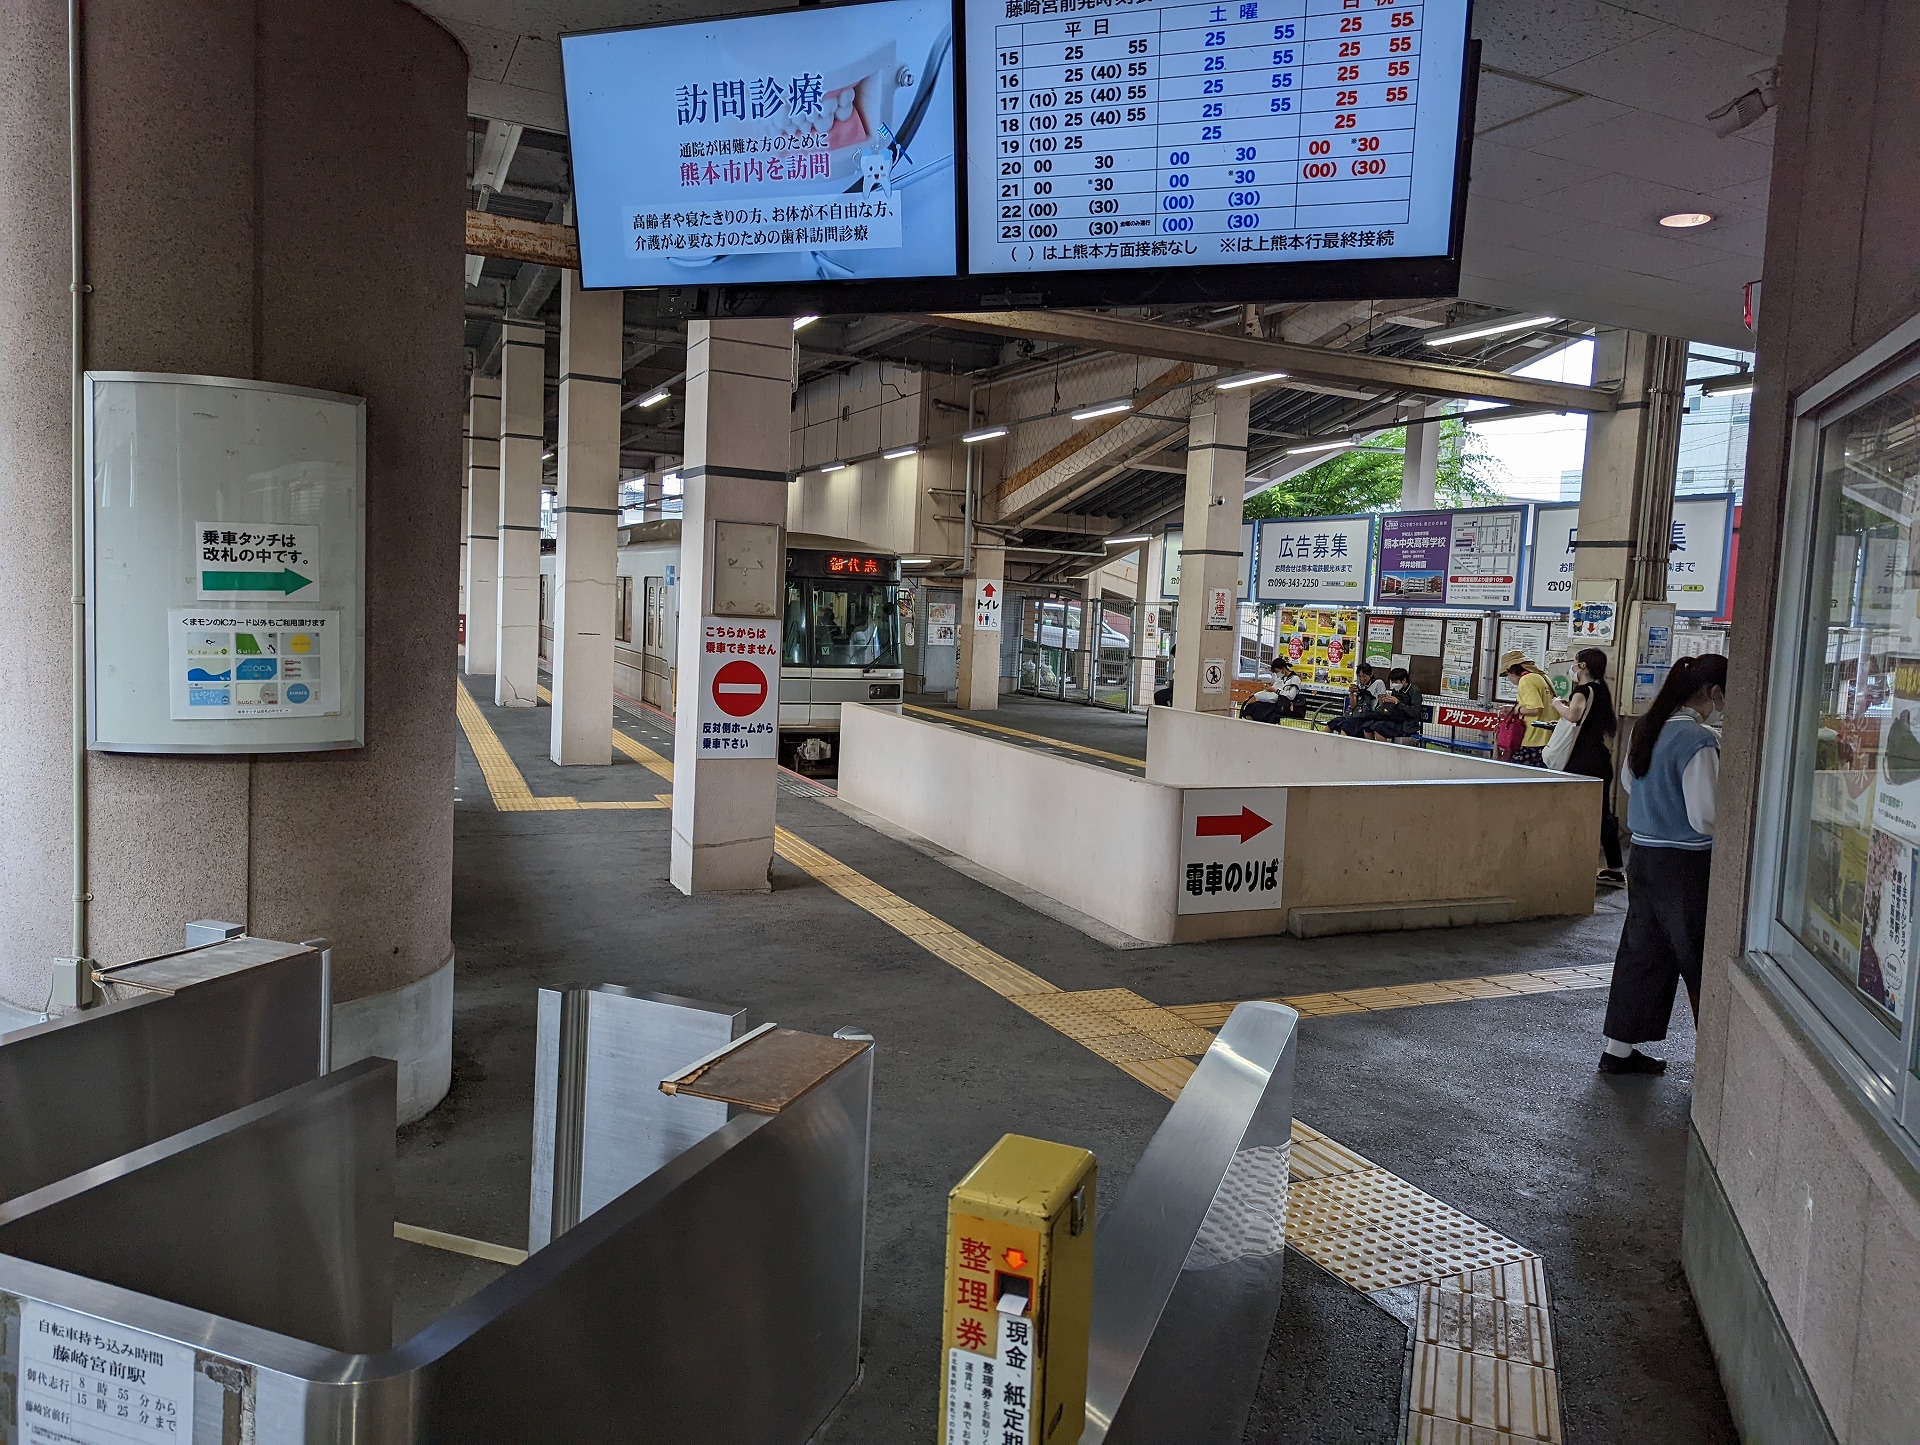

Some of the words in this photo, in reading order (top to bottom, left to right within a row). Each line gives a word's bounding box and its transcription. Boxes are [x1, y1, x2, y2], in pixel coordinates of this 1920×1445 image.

[1005, 0, 1149, 18] 藤崎宮前発
[1000, 52, 1019, 66] 15
[1064, 46, 1084, 60] 25
[1128, 39, 1148, 54] 55
[1205, 31, 1226, 46] 25
[1274, 24, 1295, 40] 55
[1340, 16, 1362, 33] 25
[1391, 12, 1413, 28] 55
[1000, 74, 1019, 88] 16
[1064, 68, 1084, 82] 25
[1091, 64, 1122, 81] (40)
[1128, 62, 1147, 76] 55
[1204, 56, 1224, 71] 25
[1272, 49, 1294, 65] 55
[1338, 41, 1361, 58] 25
[1389, 36, 1412, 52] 55
[1000, 96, 1020, 110] 17
[1030, 93, 1057, 109] (10)
[1064, 90, 1084, 105] 25
[1091, 86, 1122, 104] (40)
[1127, 84, 1146, 100] 55
[1203, 78, 1224, 94] 25
[1271, 72, 1292, 88] 55
[1337, 65, 1360, 82] 25
[1388, 60, 1410, 77] 55
[676, 72, 824, 126] 訪問診療
[1000, 118, 1020, 132] 18
[1030, 115, 1057, 131] (10)
[1064, 112, 1083, 128] 25
[1090, 109, 1122, 126] (40)
[1127, 108, 1146, 122] 55
[1202, 102, 1223, 118] 25
[1270, 97, 1292, 112] 55
[1336, 90, 1358, 106] 25
[1386, 86, 1408, 102] 55
[680, 133, 828, 158] 通院が困難な方のために
[1001, 140, 1020, 154] 19
[1030, 136, 1057, 152] (10)
[1064, 136, 1083, 150] 25
[1202, 126, 1222, 140] 25
[1334, 113, 1356, 130] 25
[680, 152, 830, 187] 熊本市内を訪問
[1001, 161, 1022, 175] 20
[1034, 159, 1052, 173] 00
[1094, 154, 1114, 169] 30
[1170, 151, 1190, 166] 00
[1236, 146, 1256, 162] 30
[1309, 140, 1331, 156] 00
[1001, 183, 1020, 197] 21
[1034, 182, 1052, 195] 00
[1169, 174, 1190, 188] 00
[1303, 162, 1338, 179] (00)
[1351, 158, 1386, 176] (30)
[632, 200, 894, 231] 高齢者や寝たきりの方、お体が不自由な方、
[1001, 204, 1022, 218] 22
[1028, 202, 1058, 218] (00)
[1088, 198, 1118, 214] (30)
[1163, 194, 1194, 210] (00)
[1228, 190, 1260, 208] (30)
[634, 225, 868, 252] 介護が必要な方のための歯科訪問診療
[1001, 225, 1022, 238] 23
[1028, 223, 1058, 239] (00)
[1088, 220, 1118, 236] (30)
[1162, 217, 1194, 233] (00)
[1227, 214, 1260, 230] (30)
[202, 530, 296, 548] 乗車タッチは
[1278, 533, 1348, 559] 広告募集
[1384, 536, 1446, 549] 熊本中央高等学校
[202, 548, 308, 565] 改札の中です。
[830, 557, 878, 572] 御代志
[1274, 578, 1318, 588] 096-343-2250
[976, 598, 1000, 610] トイレ
[1214, 592, 1226, 616] 禁煙
[182, 618, 326, 627] くまモンのICカード以外もご利用頂けます
[706, 626, 766, 640] こちらからは
[706, 642, 776, 656] 乗車できません
[702, 722, 774, 734] 反対側ホームから
[1443, 709, 1504, 728] アサヒファイナン
[702, 738, 748, 750] 乗車下さい
[1186, 858, 1279, 896] 電車のりば
[956, 1237, 992, 1351] 整理券
[38, 1318, 164, 1366] 自転車持ち込み時間
[52, 1344, 146, 1384] 藤崎宮前駅
[26, 1367, 70, 1392] 御代志行
[78, 1377, 86, 1388] 8
[96, 1382, 108, 1396] 時
[117, 1388, 129, 1400] 55
[140, 1394, 150, 1406] 分
[155, 1400, 176, 1416] から
[25, 1400, 70, 1426] 藤崎宮前行
[76, 1392, 87, 1406] 15
[96, 1398, 108, 1412] 時
[117, 1404, 129, 1418] 25
[139, 1410, 150, 1424] 分
[155, 1416, 176, 1432] まで
